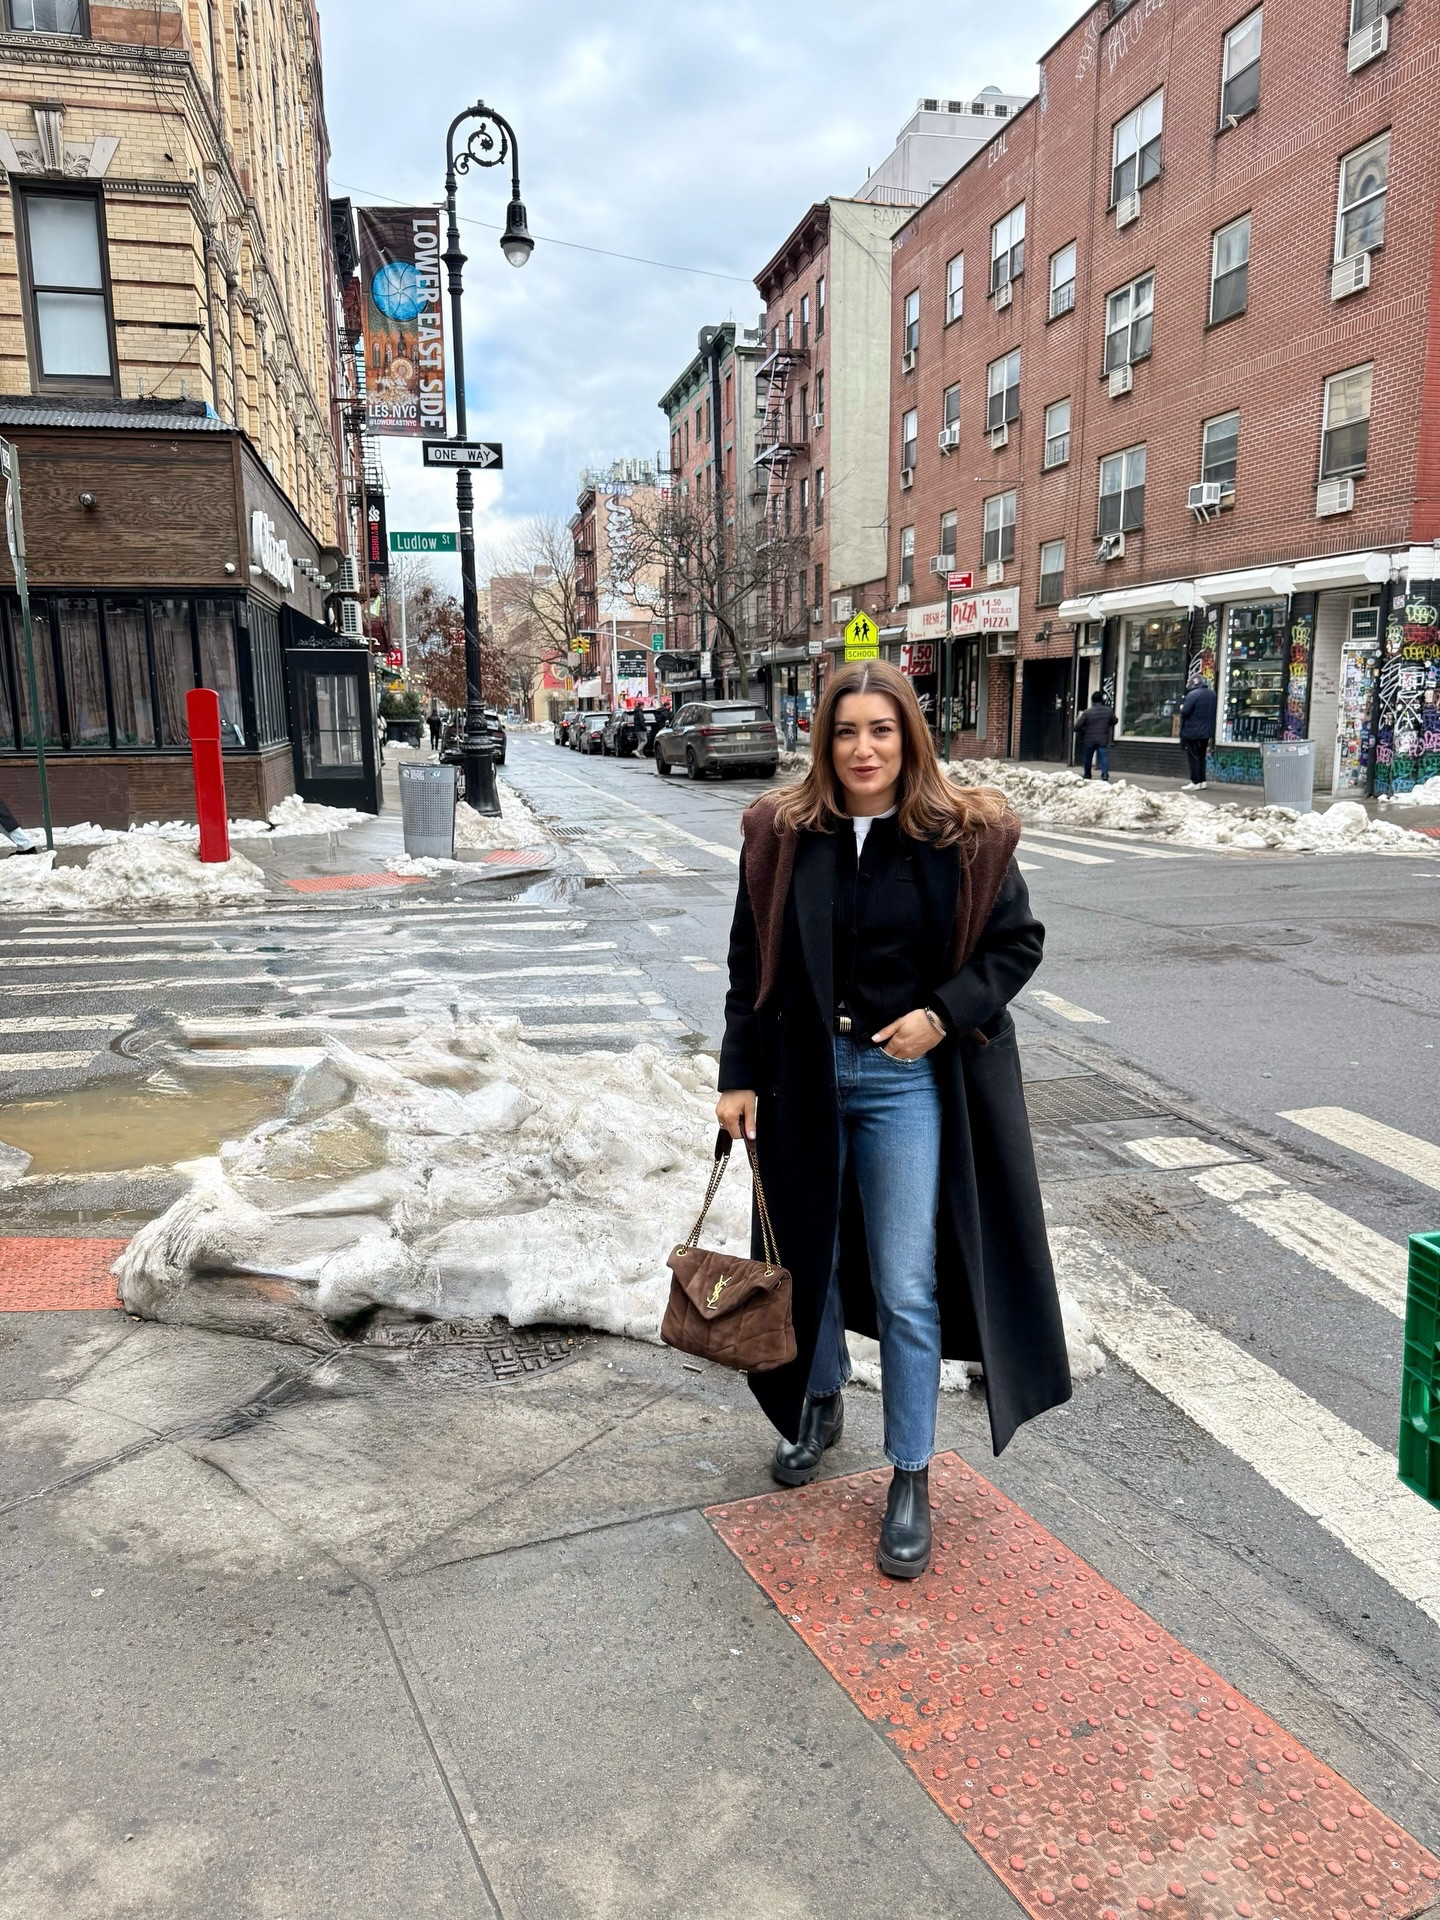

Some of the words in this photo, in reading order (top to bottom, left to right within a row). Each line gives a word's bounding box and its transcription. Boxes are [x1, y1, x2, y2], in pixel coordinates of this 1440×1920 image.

[413, 219, 440, 304] LOWER
[418, 313, 442, 370] EAST
[368, 404, 417, 419] LES.NYC
[419, 379, 444, 428] SIDE
[369, 419, 417, 427] @LOWEREASTNYC
[434, 449, 458, 460] ONE
[467, 450, 491, 461] WAY
[396, 533, 437, 550] Ludlow
[441, 534, 450, 545] St
[952, 600, 977, 625] PIZZA
[983, 616, 1009, 628] PIZZA
[847, 650, 876, 658] SCHOOL
